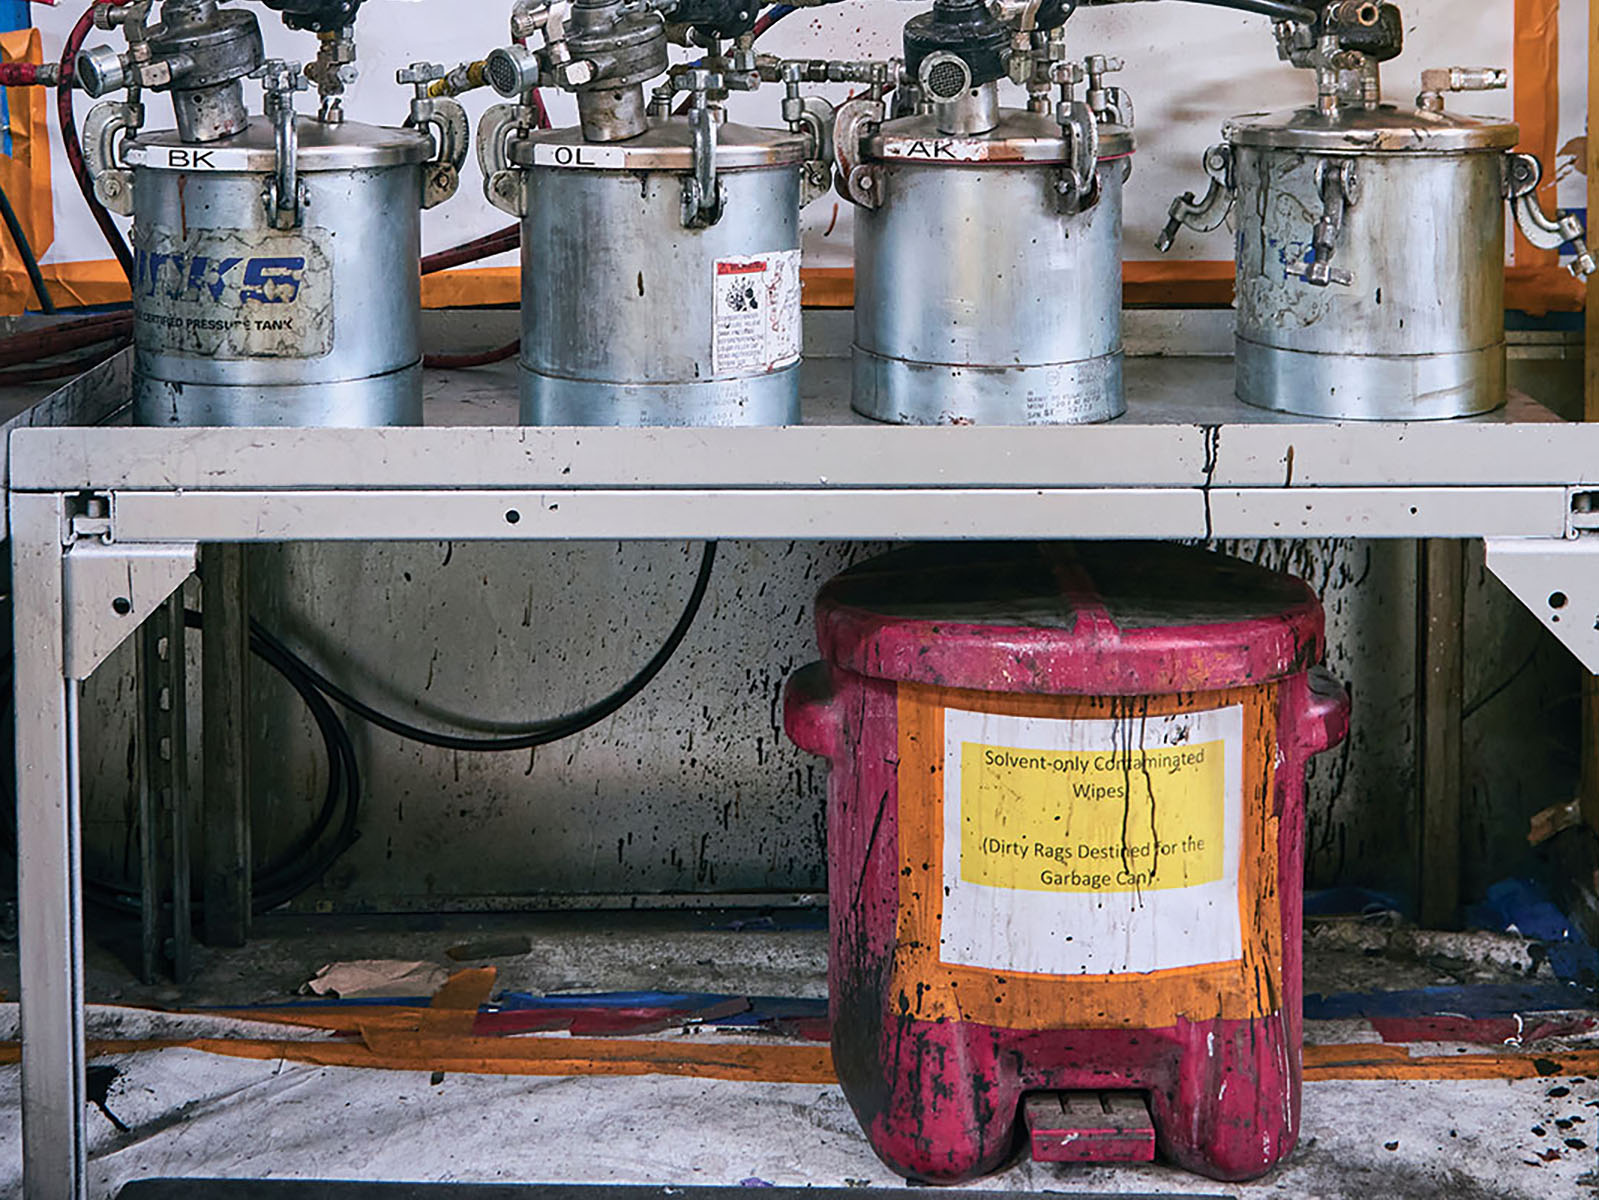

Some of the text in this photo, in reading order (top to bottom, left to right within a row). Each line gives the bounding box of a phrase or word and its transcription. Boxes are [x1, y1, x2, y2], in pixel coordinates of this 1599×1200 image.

[168, 150, 216, 169] BK
[555, 147, 595, 166] OL
[907, 141, 956, 159] AK
[254, 318, 293, 330] TANK
[985, 750, 1089, 775] Solvent-only
[1073, 783, 1124, 801] Wipes
[983, 837, 1029, 859] (Dirty
[1034, 842, 1072, 861] Rags
[1182, 838, 1205, 854] the
[1040, 868, 1153, 889] Garbage Can)
